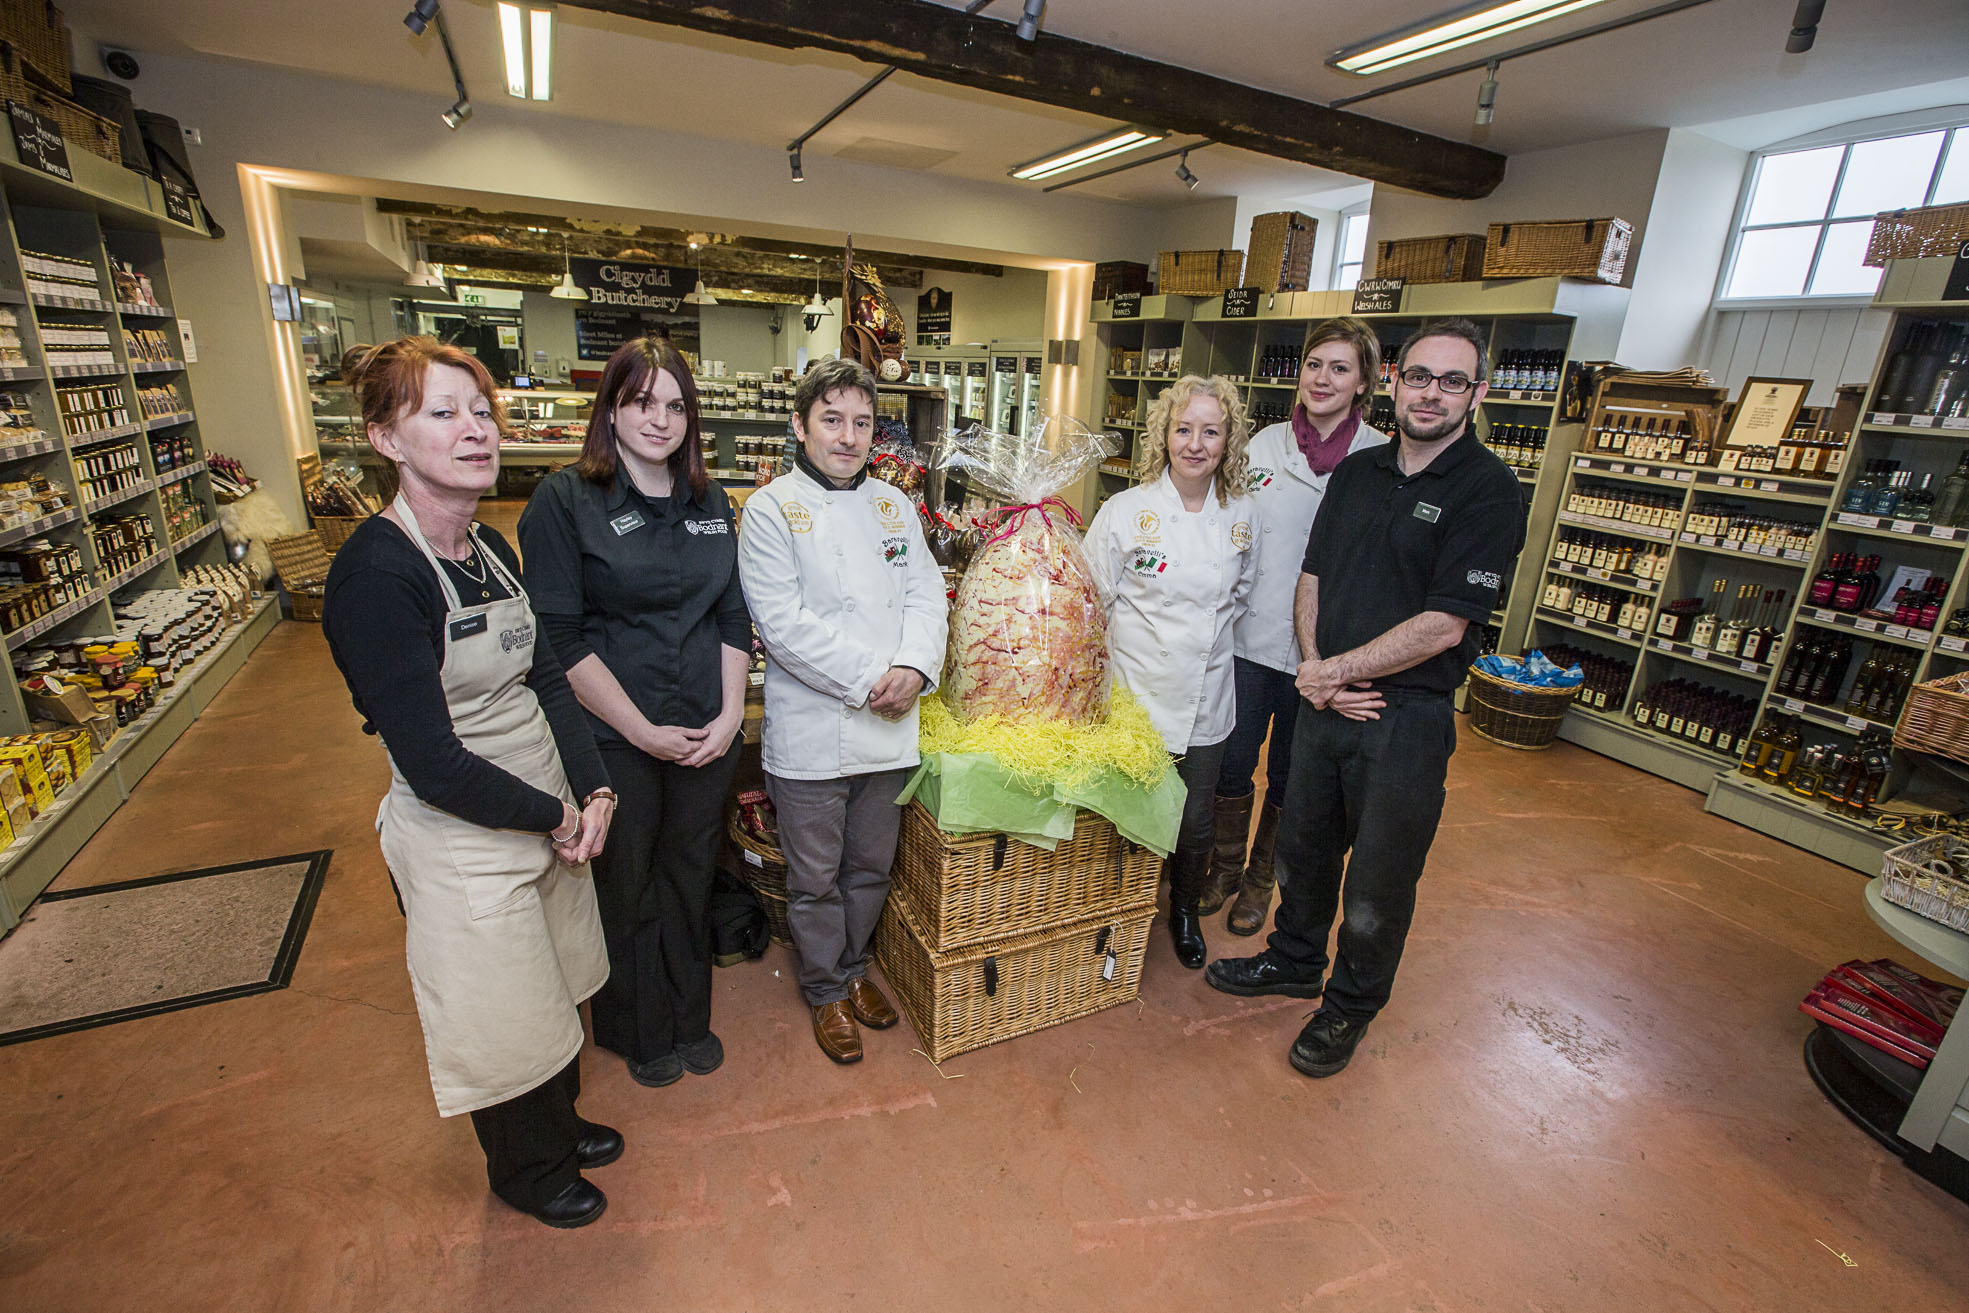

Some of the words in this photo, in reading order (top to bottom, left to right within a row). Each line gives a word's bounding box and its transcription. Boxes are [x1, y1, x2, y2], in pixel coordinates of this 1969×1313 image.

[600, 265, 671, 287] Cigydd
[1358, 280, 1382, 293] CWRW
[1382, 279, 1402, 291] CYMRU
[1228, 288, 1249, 299] SEIDR
[589, 287, 682, 312] Butchery
[1226, 306, 1246, 316] CIDER
[1354, 301, 1374, 311] WELSH
[1374, 300, 1393, 311] ALES
[698, 523, 729, 532] Bodnant
[1231, 529, 1252, 541] taste
